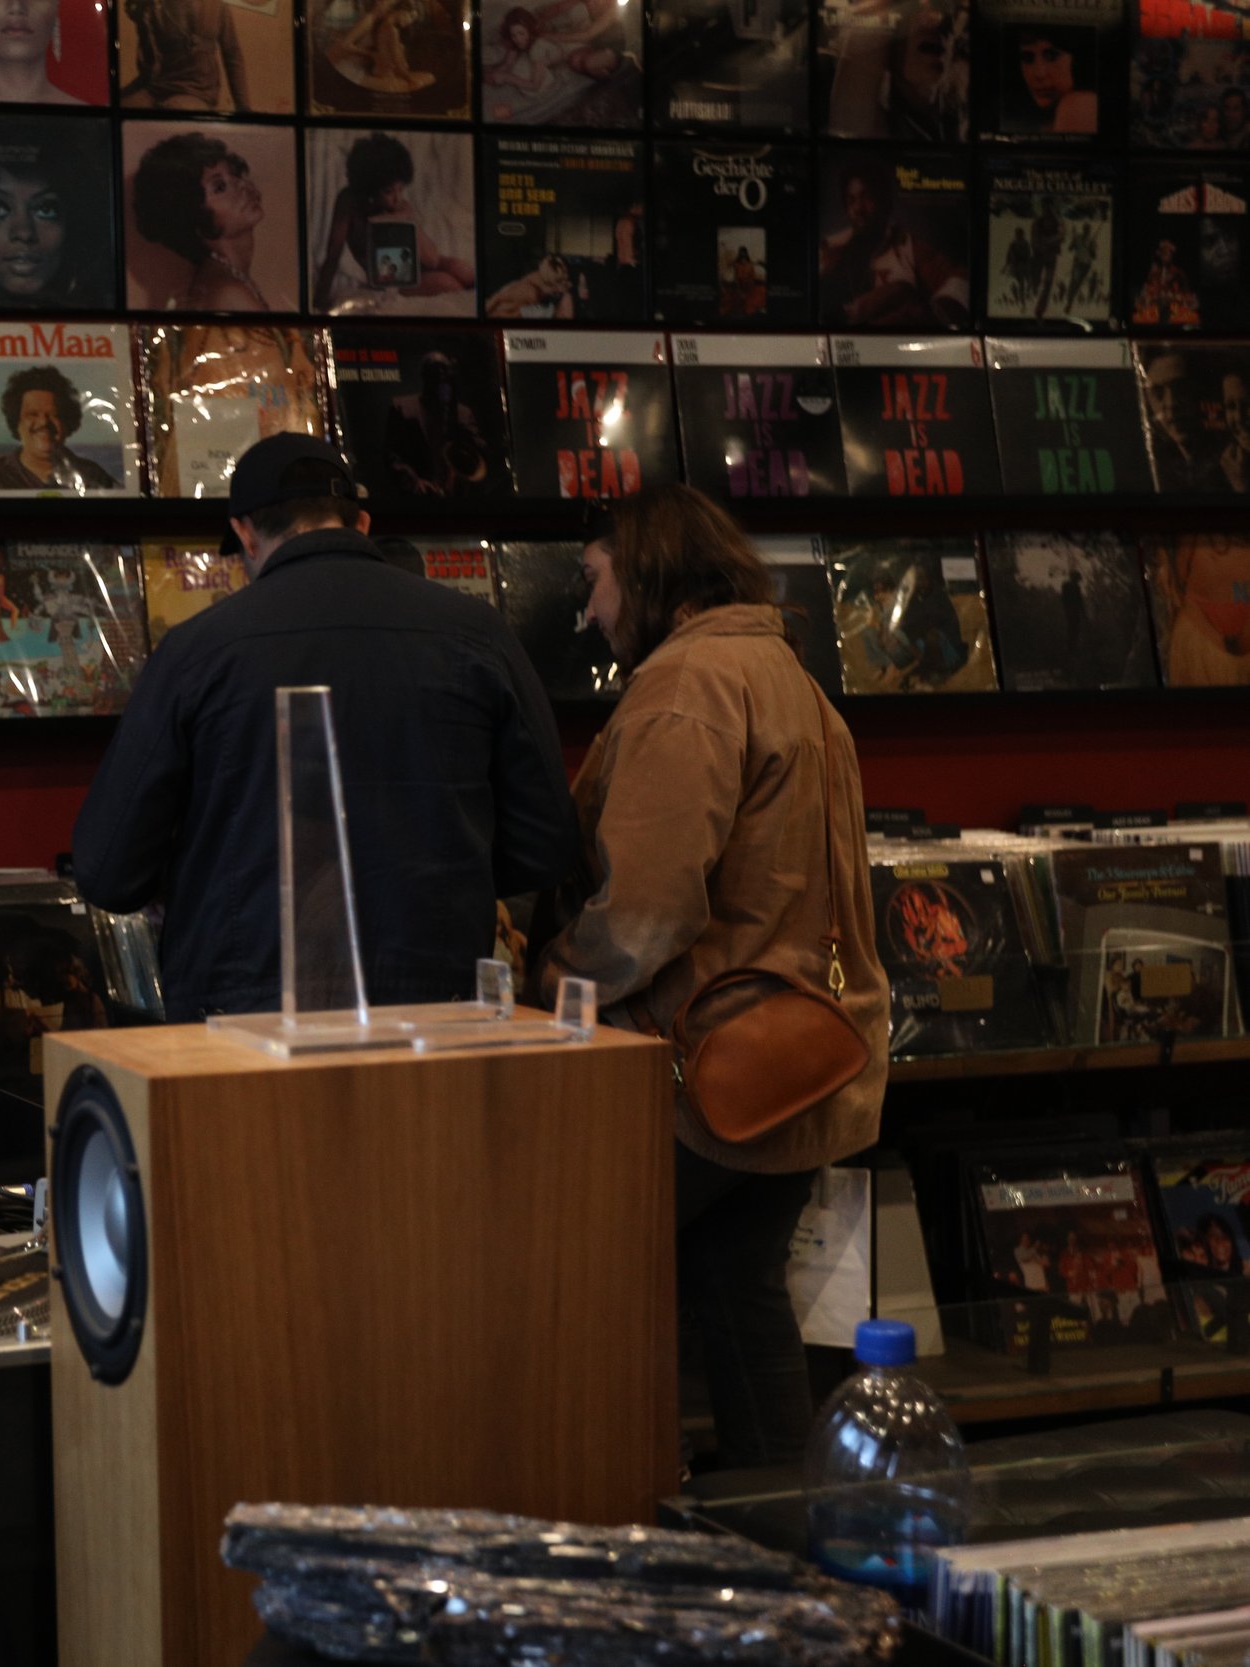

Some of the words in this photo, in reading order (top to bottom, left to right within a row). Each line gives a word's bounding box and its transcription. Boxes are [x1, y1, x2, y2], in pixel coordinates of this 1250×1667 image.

[692, 156, 775, 178] Geschichte
[713, 177, 738, 196] der
[738, 177, 769, 212] O
[29, 322, 115, 358] Maia
[970, 340, 981, 366] 6
[556, 369, 631, 420] JAZZ
[722, 372, 799, 421] JAZZ
[880, 373, 951, 421] JAZZ
[1035, 373, 1103, 421] JAZZ
[753, 421, 775, 447] IS
[910, 420, 929, 448] IS
[1062, 420, 1082, 447] IS
[557, 448, 642, 499] DEAD
[728, 449, 810, 499] DEAD
[884, 448, 965, 497] DEAD
[1038, 447, 1116, 496] DEAD
